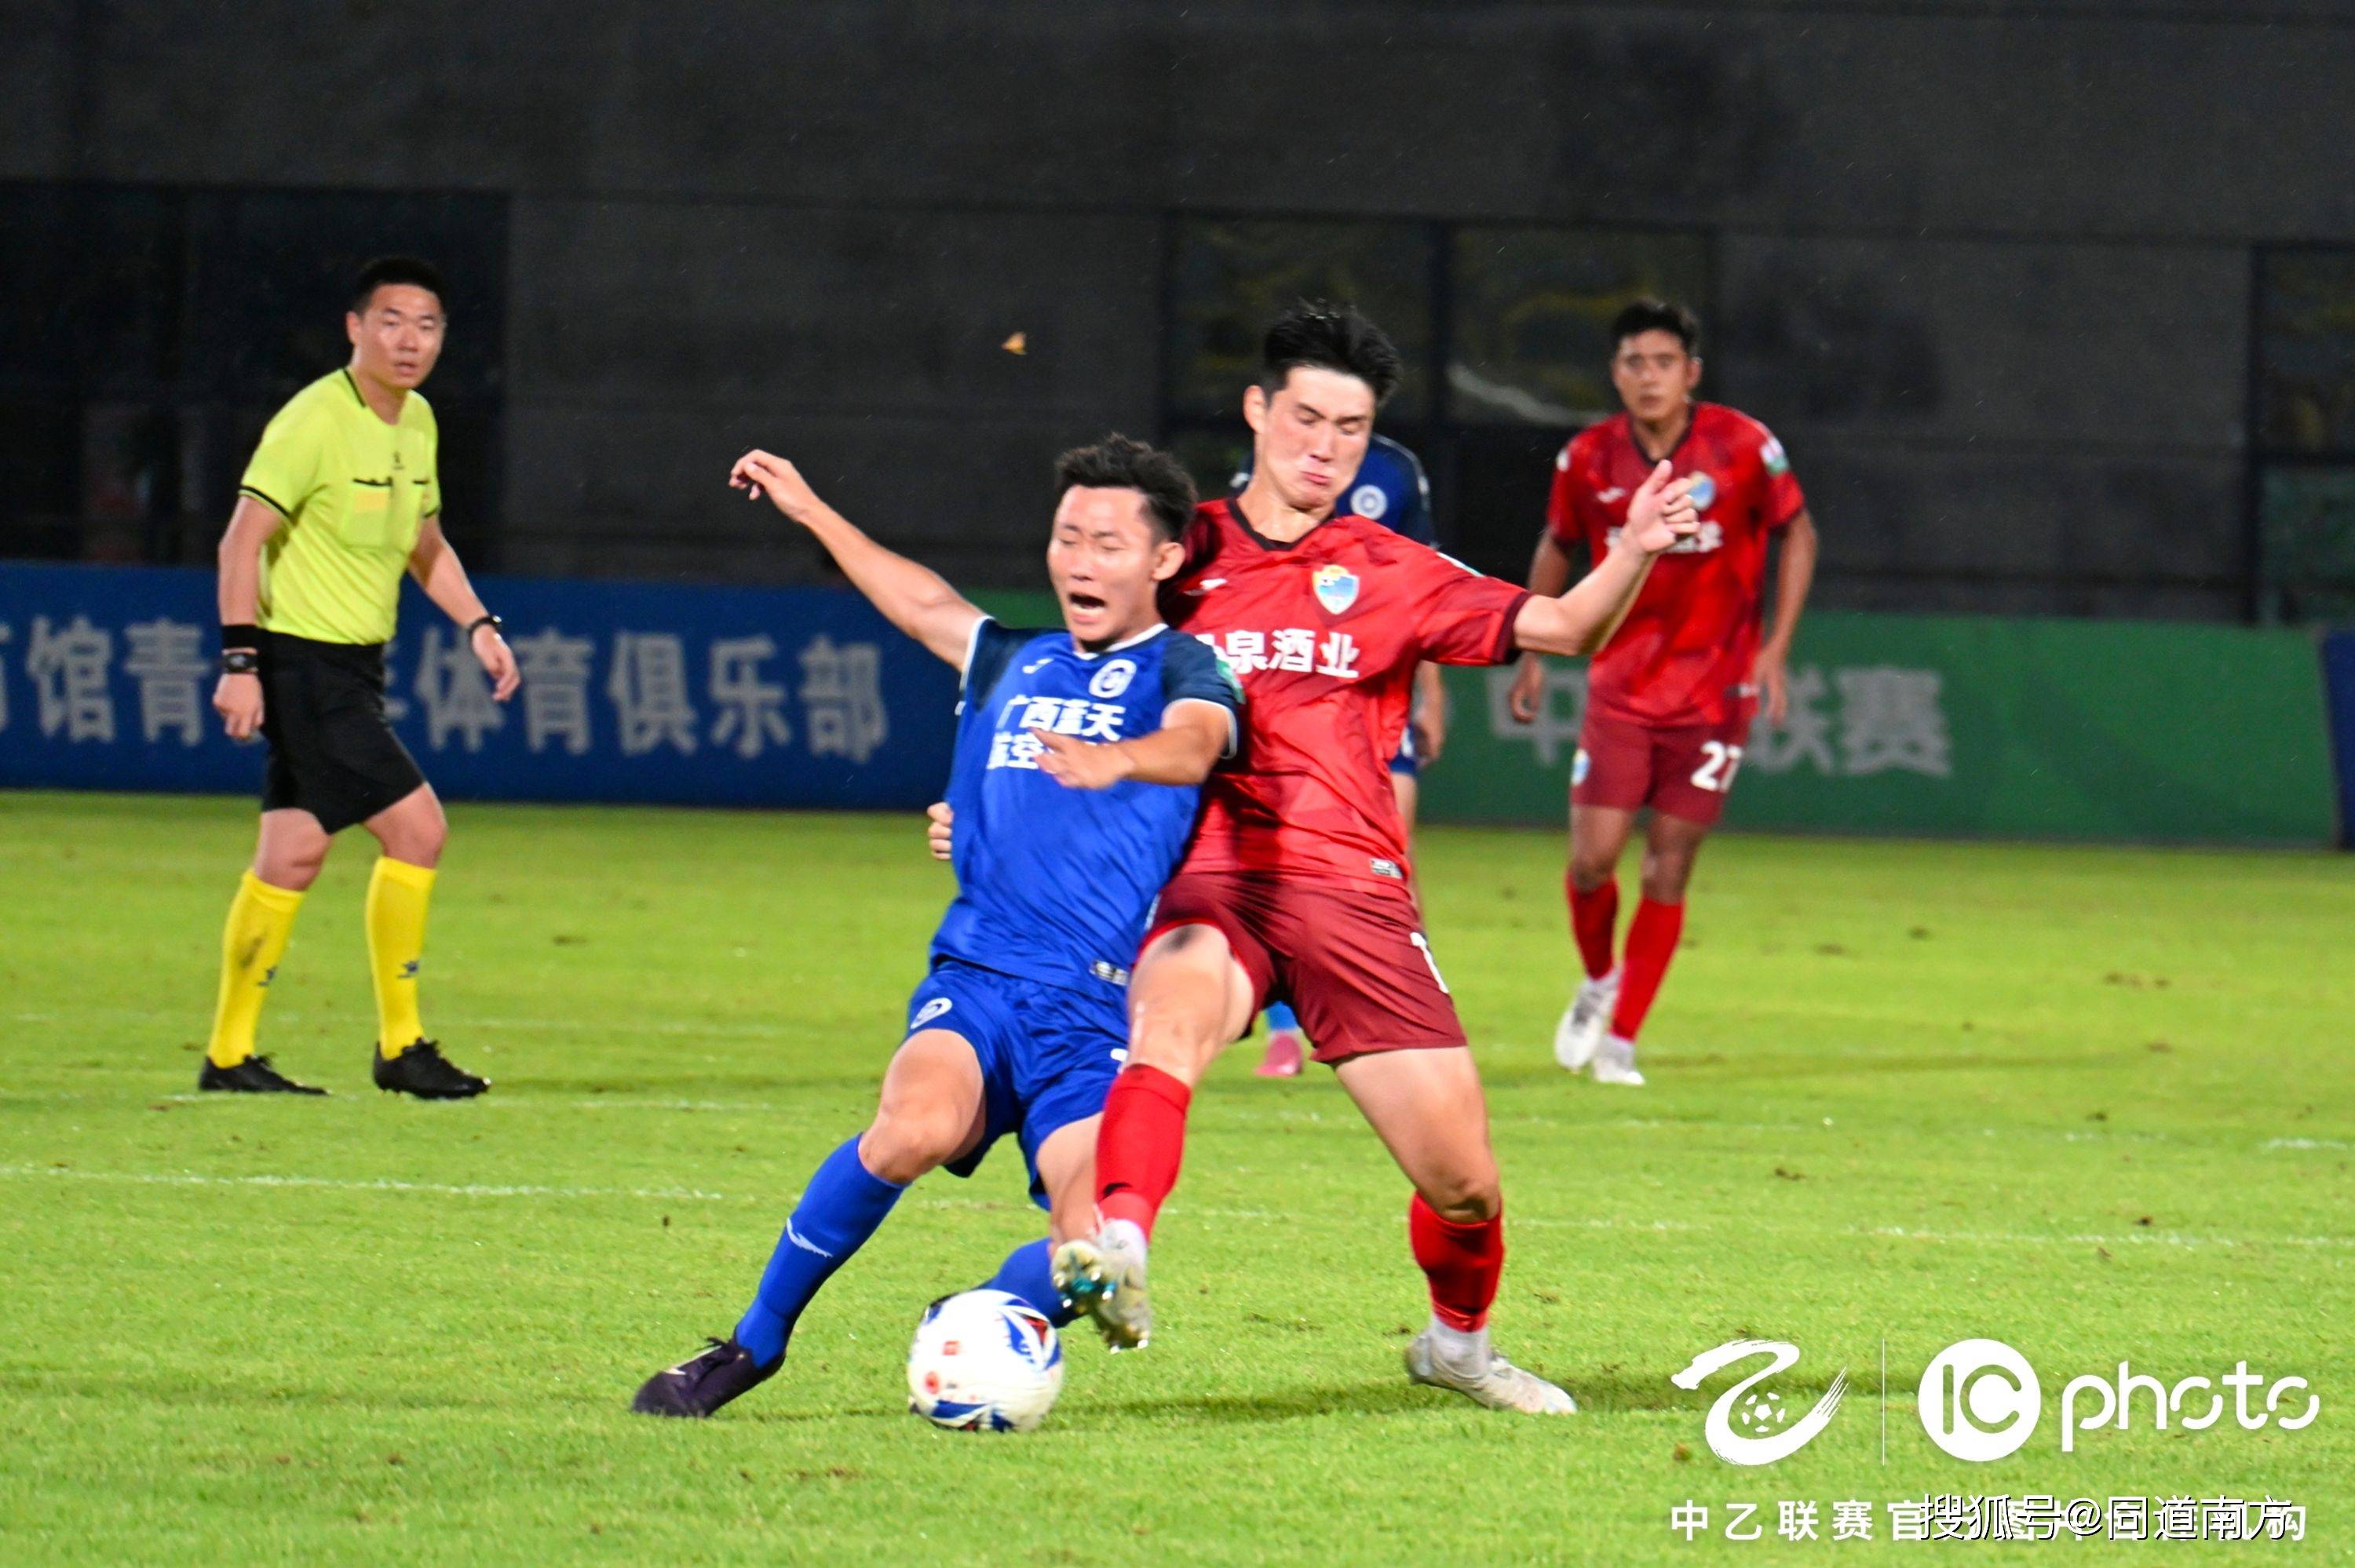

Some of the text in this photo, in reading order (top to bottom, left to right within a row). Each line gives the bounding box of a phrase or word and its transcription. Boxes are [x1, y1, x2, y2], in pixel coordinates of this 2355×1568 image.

[1195, 629, 1360, 678] 泉酒业
[1485, 664, 1952, 777] 中联赛
[1690, 740, 1743, 793] 27
